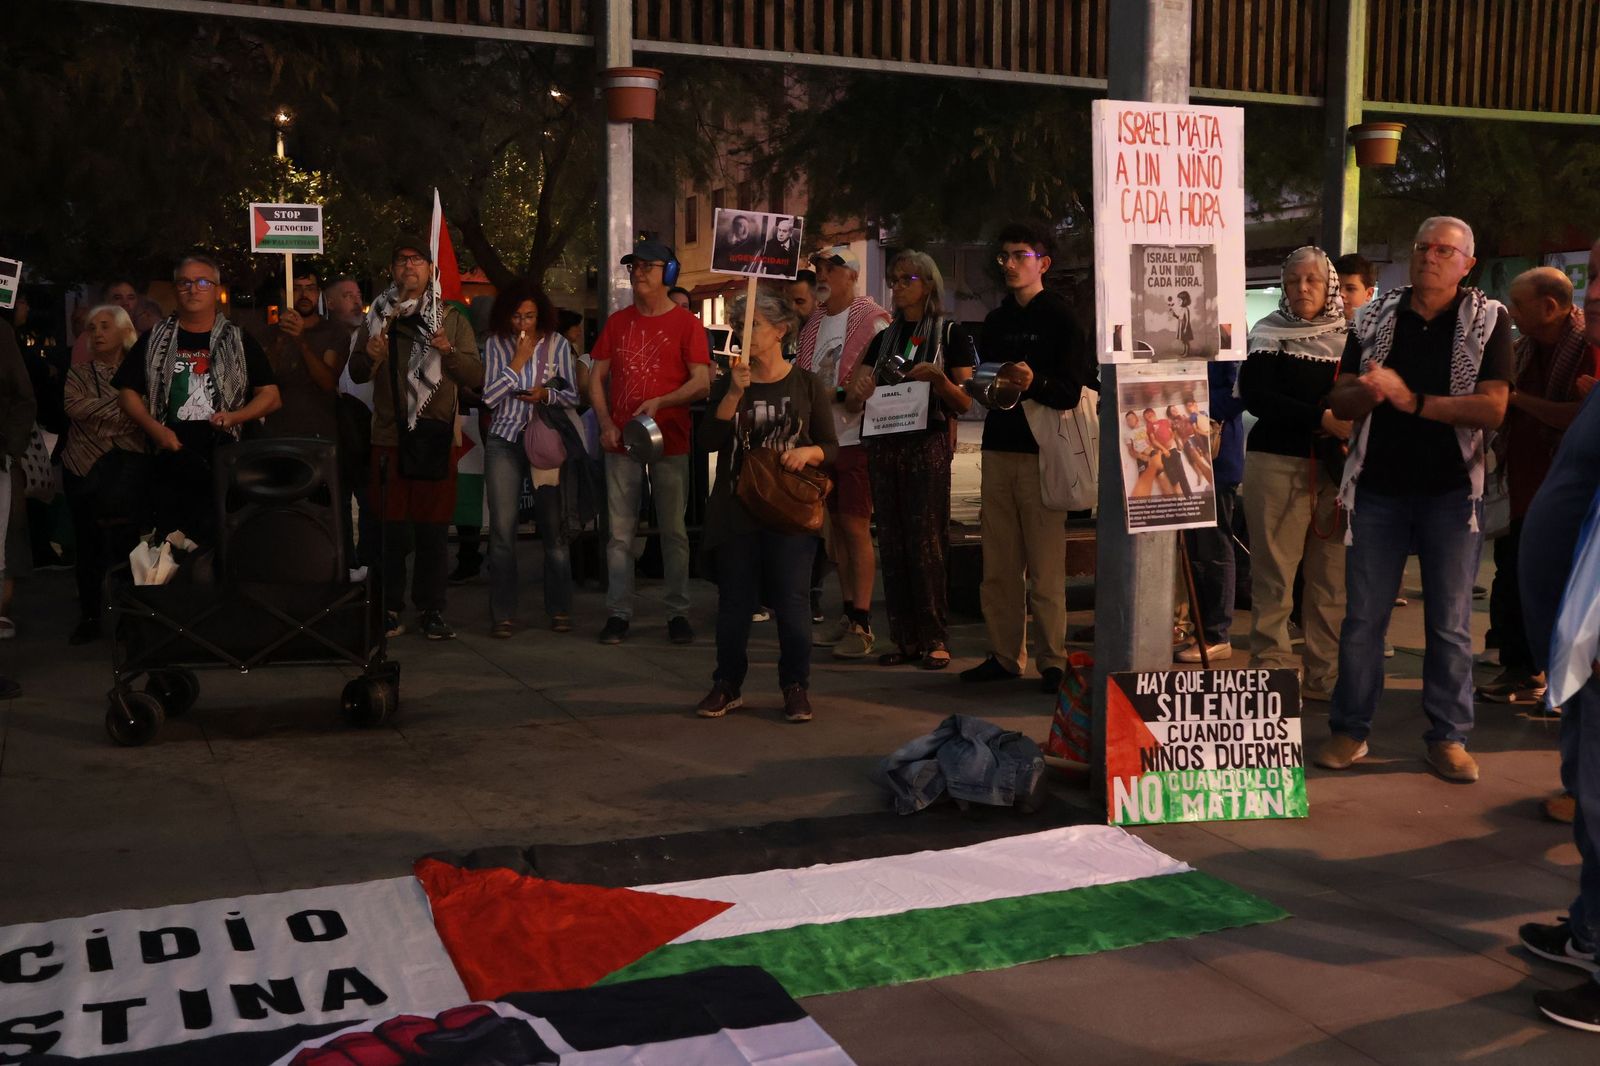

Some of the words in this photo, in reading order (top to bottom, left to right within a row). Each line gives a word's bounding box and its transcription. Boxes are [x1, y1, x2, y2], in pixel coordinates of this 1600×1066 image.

[1118, 111, 1170, 145] ISRAEL
[1177, 114, 1222, 148] MATA
[1116, 152, 1128, 185] A
[1136, 150, 1160, 186] UN
[1177, 148, 1222, 189] NIÑO
[274, 210, 301, 219] STOP
[1121, 188, 1171, 225] CADA
[1180, 191, 1224, 228] HORA
[1147, 252, 1177, 263] ISRAEL
[1180, 252, 1201, 263] MATA
[1151, 265, 1157, 275] A
[1159, 265, 1171, 275] UN
[1148, 277, 1172, 287] CADA
[1175, 277, 1202, 287] HORA.
[1137, 671, 1169, 694] HAY
[1175, 671, 1205, 693] QUE
[1213, 670, 1270, 692] HACER
[1156, 692, 1282, 722] SILENCIO
[1167, 722, 1244, 743] CUANDO
[1252, 718, 1288, 741] LOS
[1140, 742, 1204, 772] NIÑOS
[1215, 742, 1303, 770] DUERMEN
[1168, 770, 1247, 791] CUANDO
[1254, 768, 1294, 789] LOS
[1113, 775, 1163, 823] NO
[1183, 790, 1285, 819] MATAN
